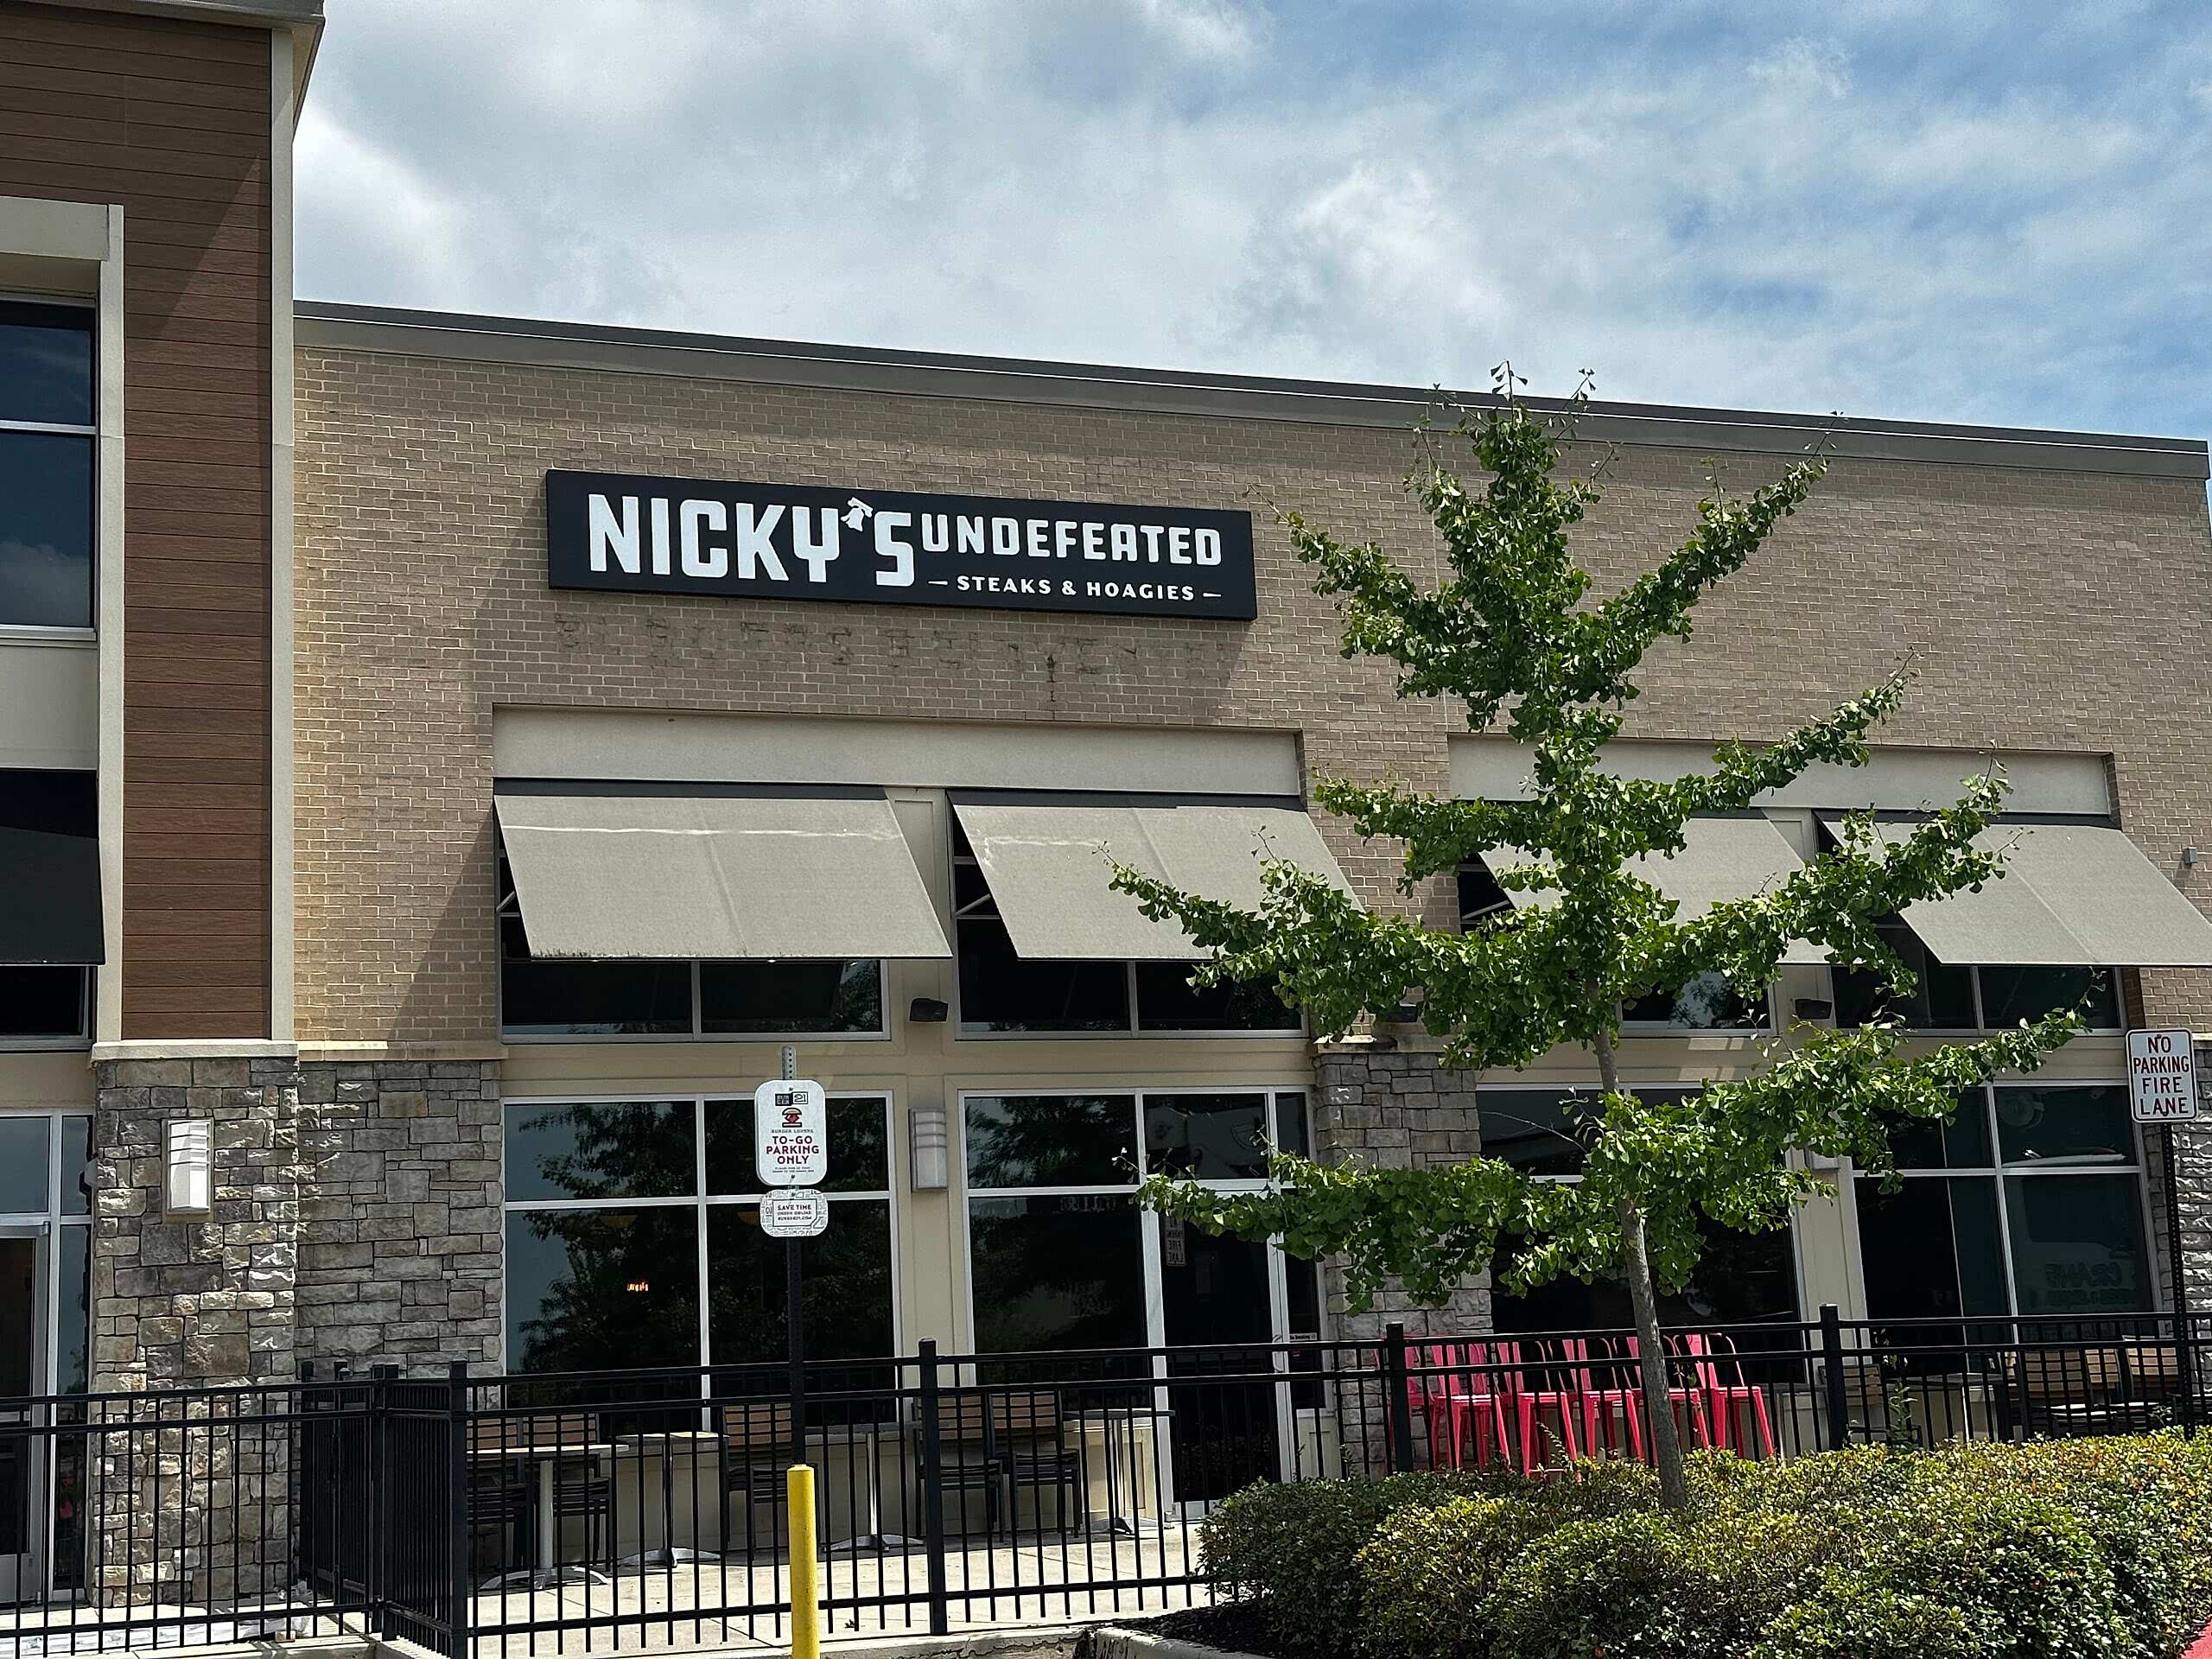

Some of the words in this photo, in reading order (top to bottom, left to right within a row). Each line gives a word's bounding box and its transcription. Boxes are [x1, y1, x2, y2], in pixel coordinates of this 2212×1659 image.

[588, 493, 915, 587] NICKY'S
[922, 512, 1222, 566] UNDEFEATED
[957, 575, 1052, 594] STEAKS
[1062, 581, 1077, 594] &
[1087, 582, 1194, 601] HOAGIES
[2148, 1036, 2171, 1053] NO
[2133, 1056, 2190, 1074] PARKING
[2142, 1077, 2183, 1094] FIRE
[794, 1094, 806, 1103] 21
[2140, 1097, 2189, 1115] LANE
[772, 1135, 812, 1145] TO-GO
[766, 1145, 819, 1154] PARKING
[777, 1155, 809, 1165] ONLY
